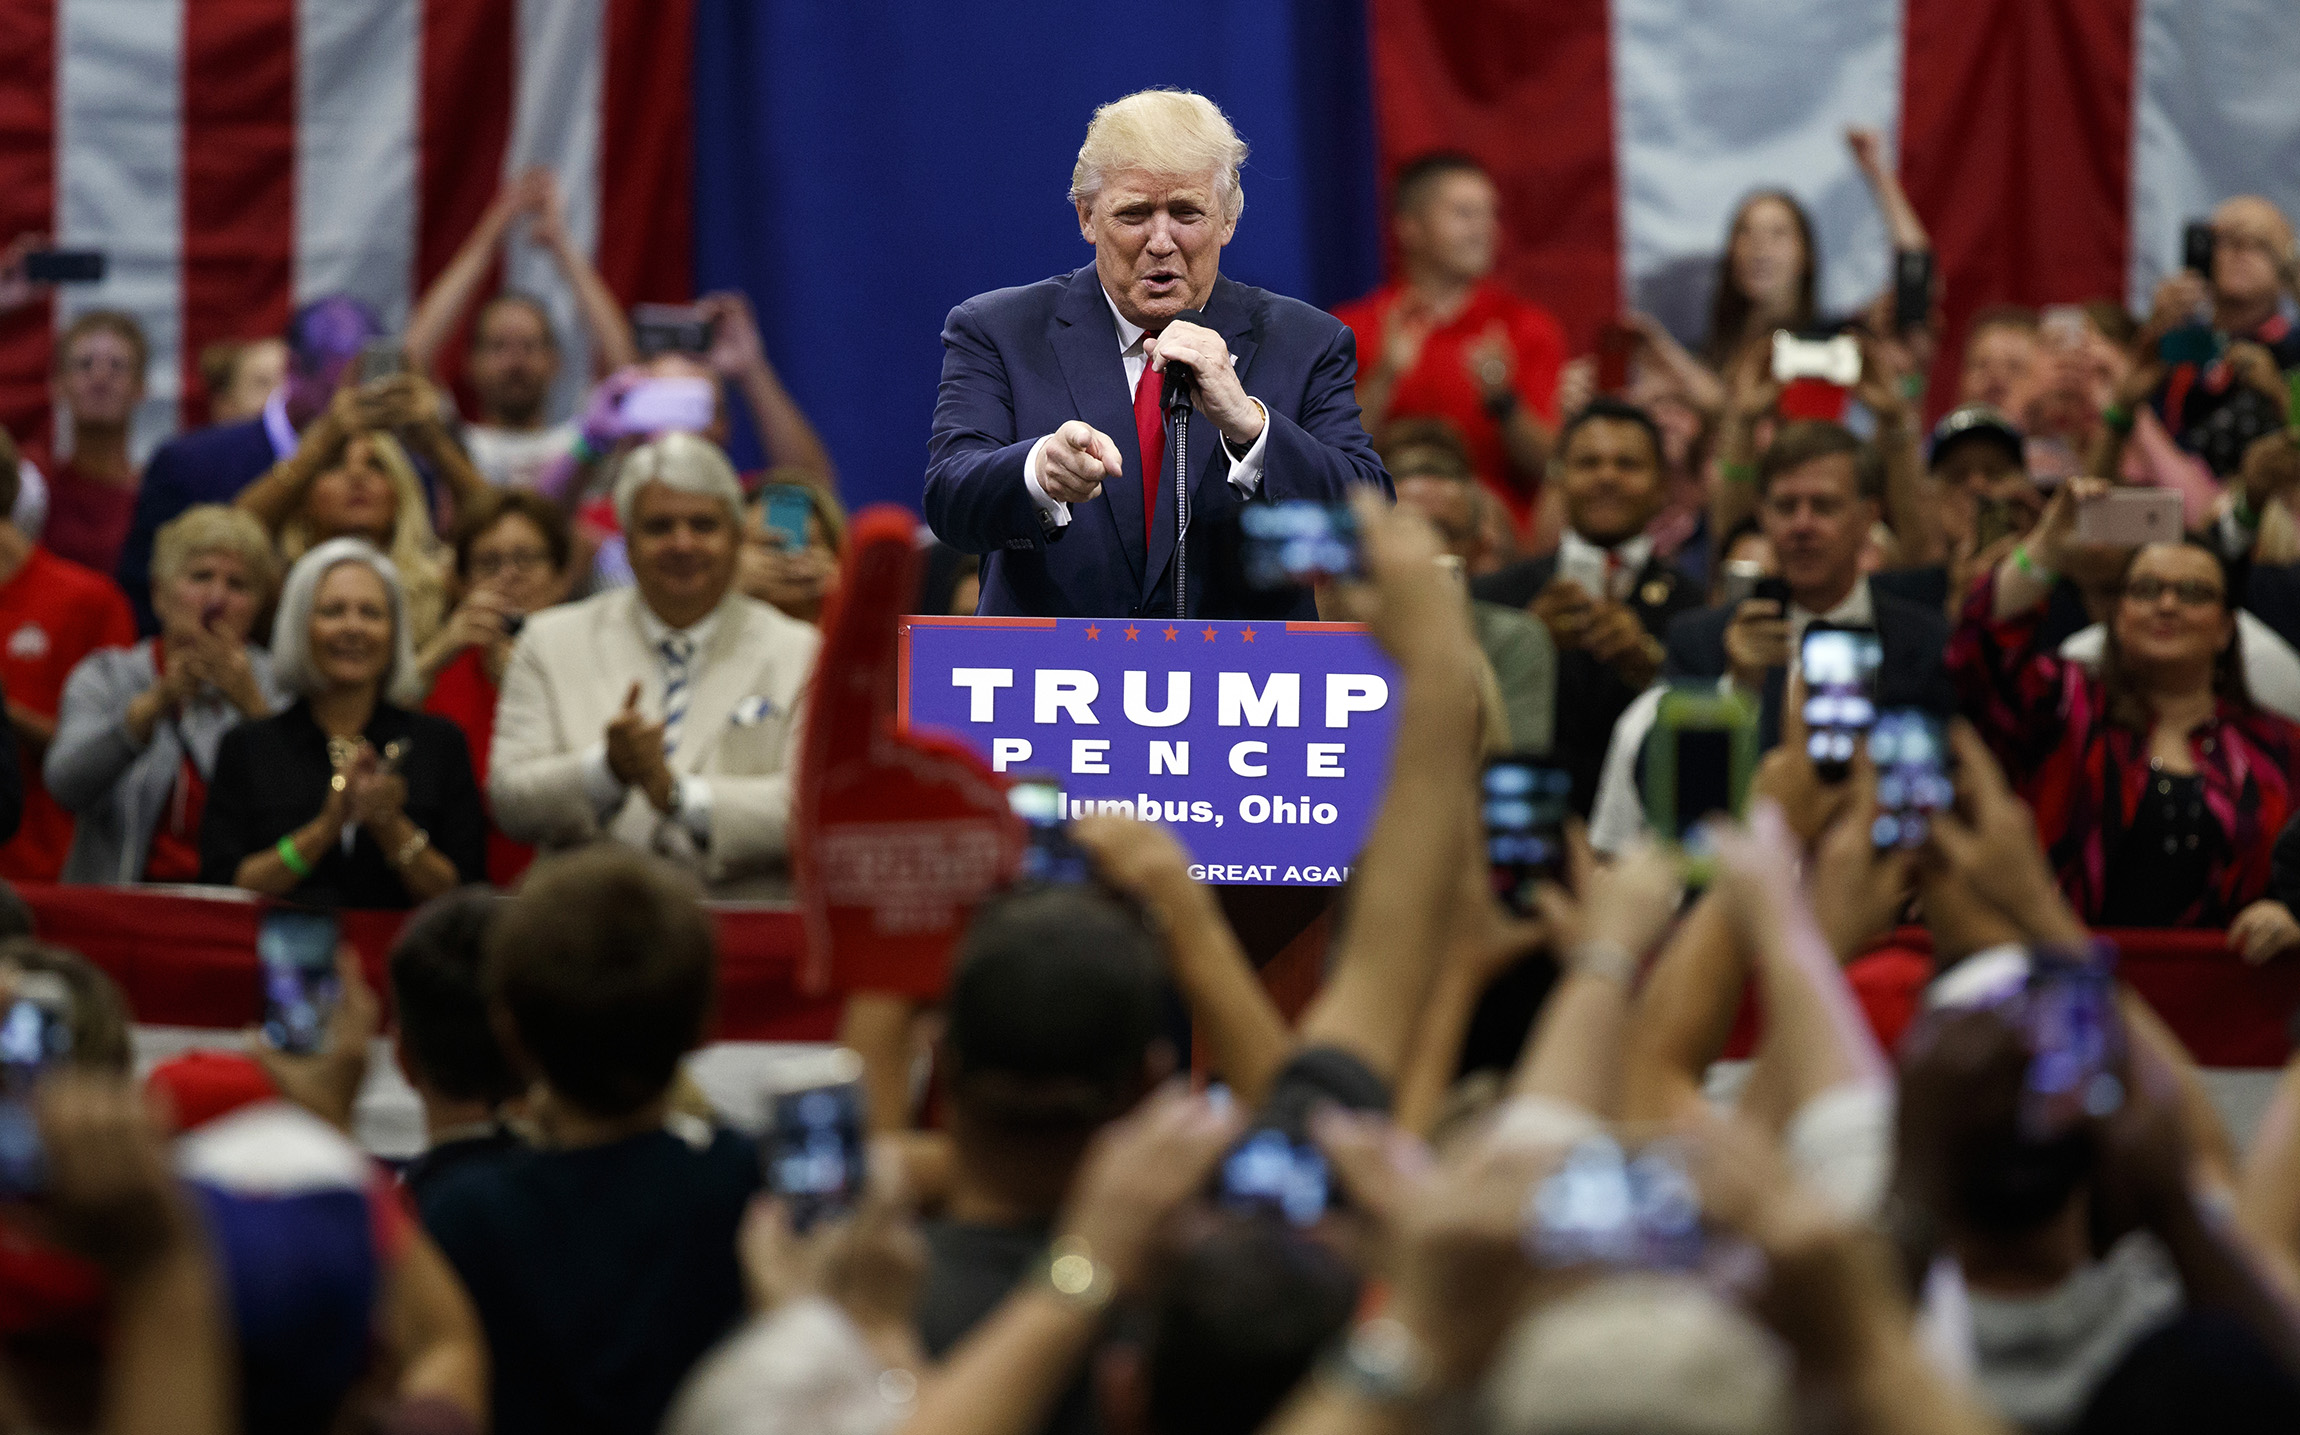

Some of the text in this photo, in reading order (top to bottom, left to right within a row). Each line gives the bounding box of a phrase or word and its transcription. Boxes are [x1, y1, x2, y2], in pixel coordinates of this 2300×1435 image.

[951, 667, 1389, 728] TRUMP
[992, 737, 1346, 778] PENCE
[1057, 792, 1338, 828] lumbus, Ohio
[1186, 864, 1349, 883] GREAT AGAI
